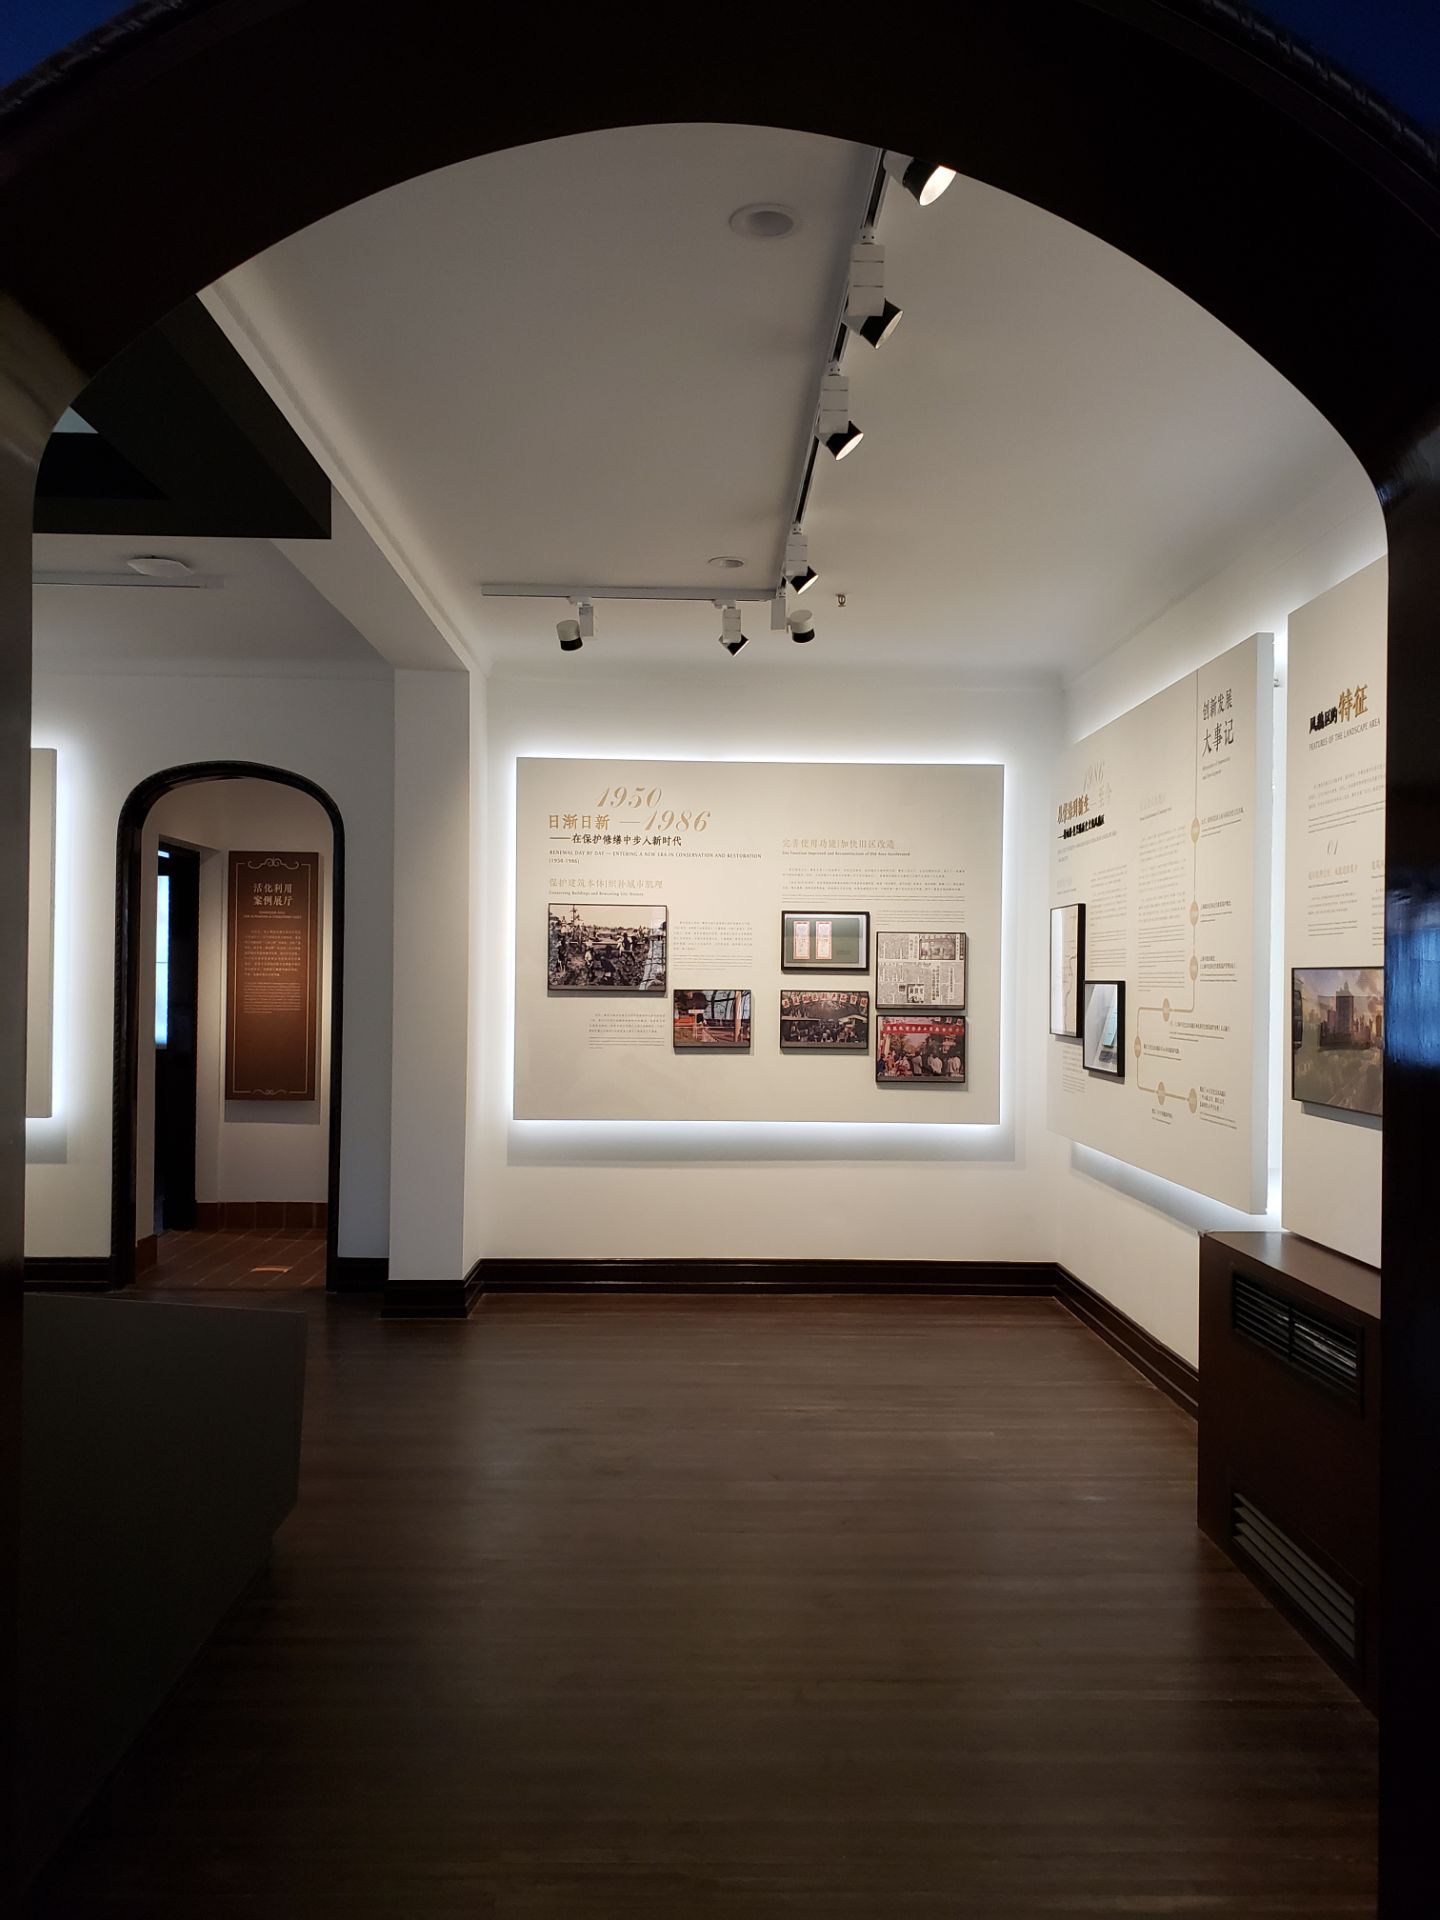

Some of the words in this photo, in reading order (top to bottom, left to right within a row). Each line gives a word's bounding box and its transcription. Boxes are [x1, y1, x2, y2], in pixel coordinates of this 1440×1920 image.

[1202, 718, 1234, 757] 大事记
[596, 786, 662, 808] 1950
[549, 813, 610, 831] 日渐日新
[253, 882, 293, 893] 活化利用
[253, 895, 294, 906] 案例展厅
